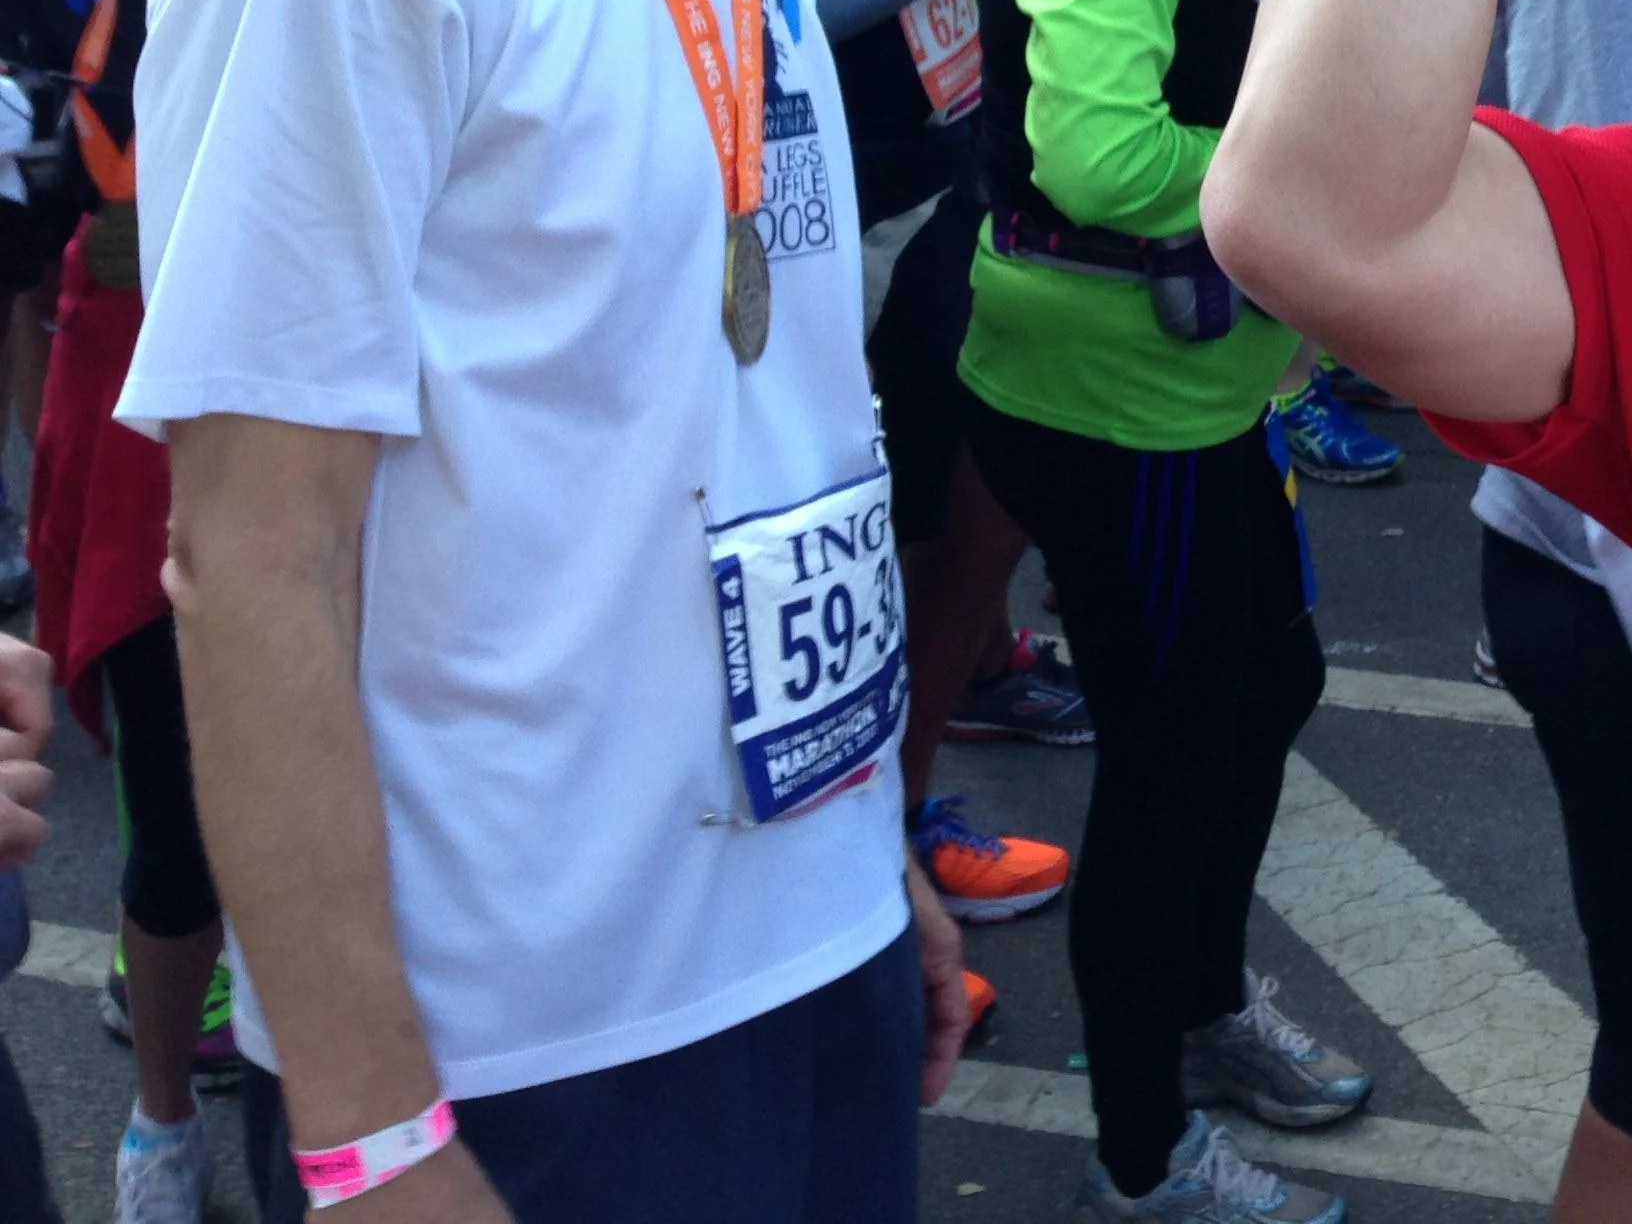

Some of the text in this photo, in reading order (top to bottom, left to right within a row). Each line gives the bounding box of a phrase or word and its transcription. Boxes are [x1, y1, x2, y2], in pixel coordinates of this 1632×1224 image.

[697, 39, 722, 90] ING
[777, 139, 822, 172] LEGS
[786, 502, 888, 586] ING
[722, 576, 753, 698] WAVE 4
